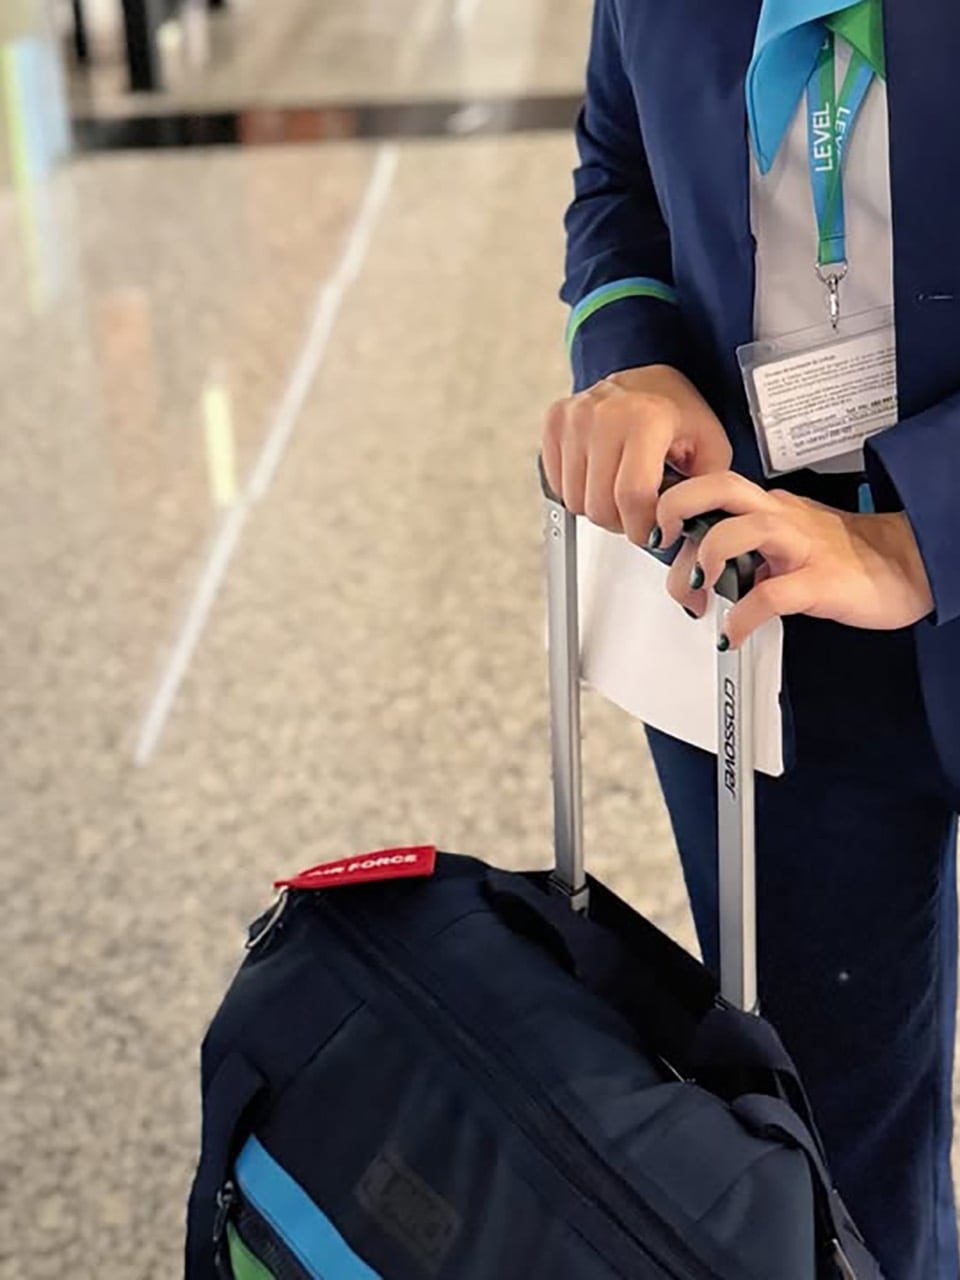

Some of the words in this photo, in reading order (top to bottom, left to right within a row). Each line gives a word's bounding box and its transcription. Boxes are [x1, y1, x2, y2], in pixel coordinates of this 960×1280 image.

[813, 101, 832, 172] LEVEL
[834, 106, 851, 158] LEV
[724, 677, 737, 800] crossover
[348, 854, 417, 872] FORCE
